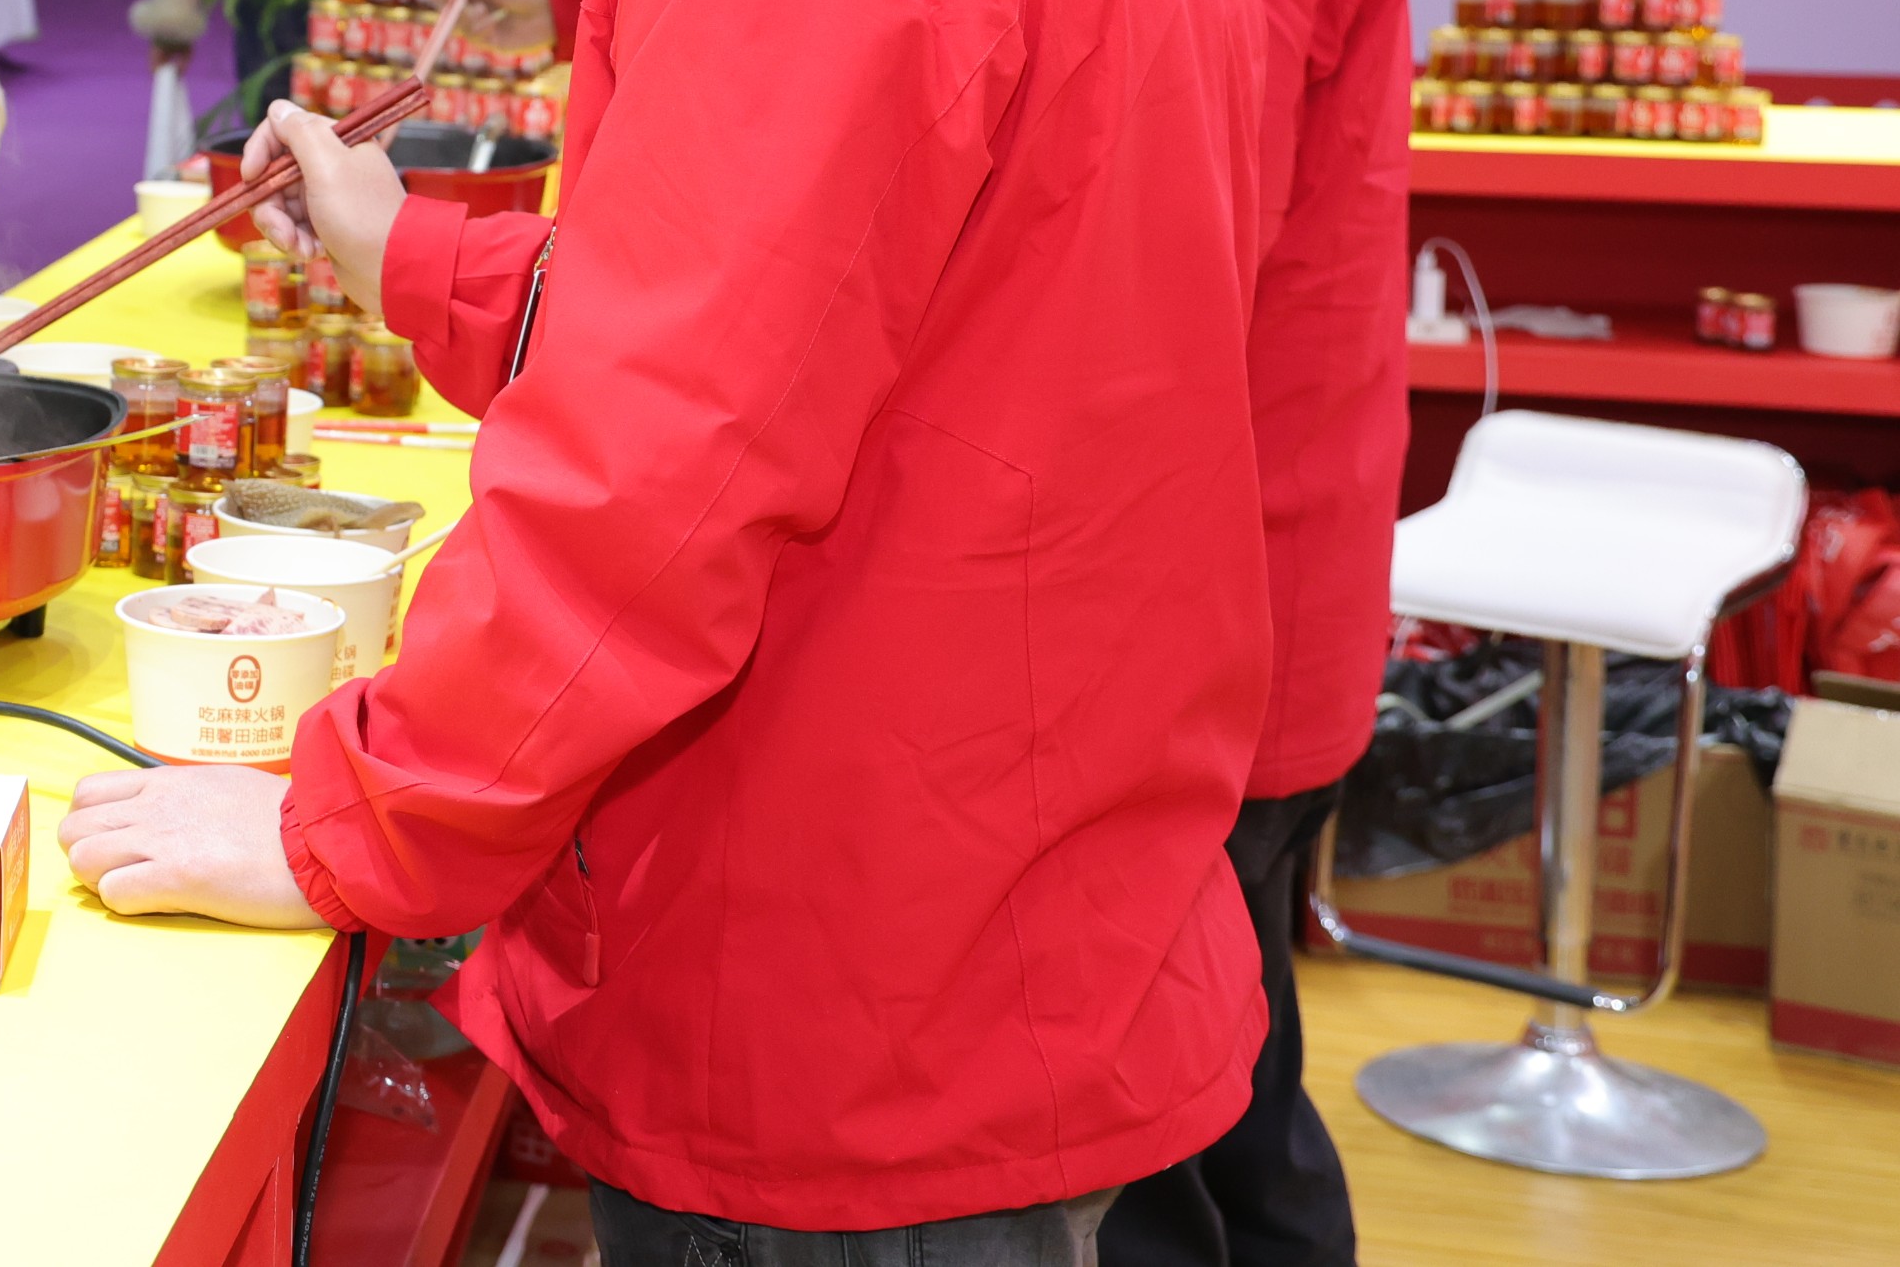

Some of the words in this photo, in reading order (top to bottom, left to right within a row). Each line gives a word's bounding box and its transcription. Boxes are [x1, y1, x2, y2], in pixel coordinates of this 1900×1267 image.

[231, 669, 259, 680] 零添加
[234, 680, 254, 690] 油碟
[198, 705, 285, 724] 吃麻辣火锅
[198, 726, 284, 745] 用馨田油碟
[240, 749, 260, 757] 4000
[261, 747, 276, 757] 023
